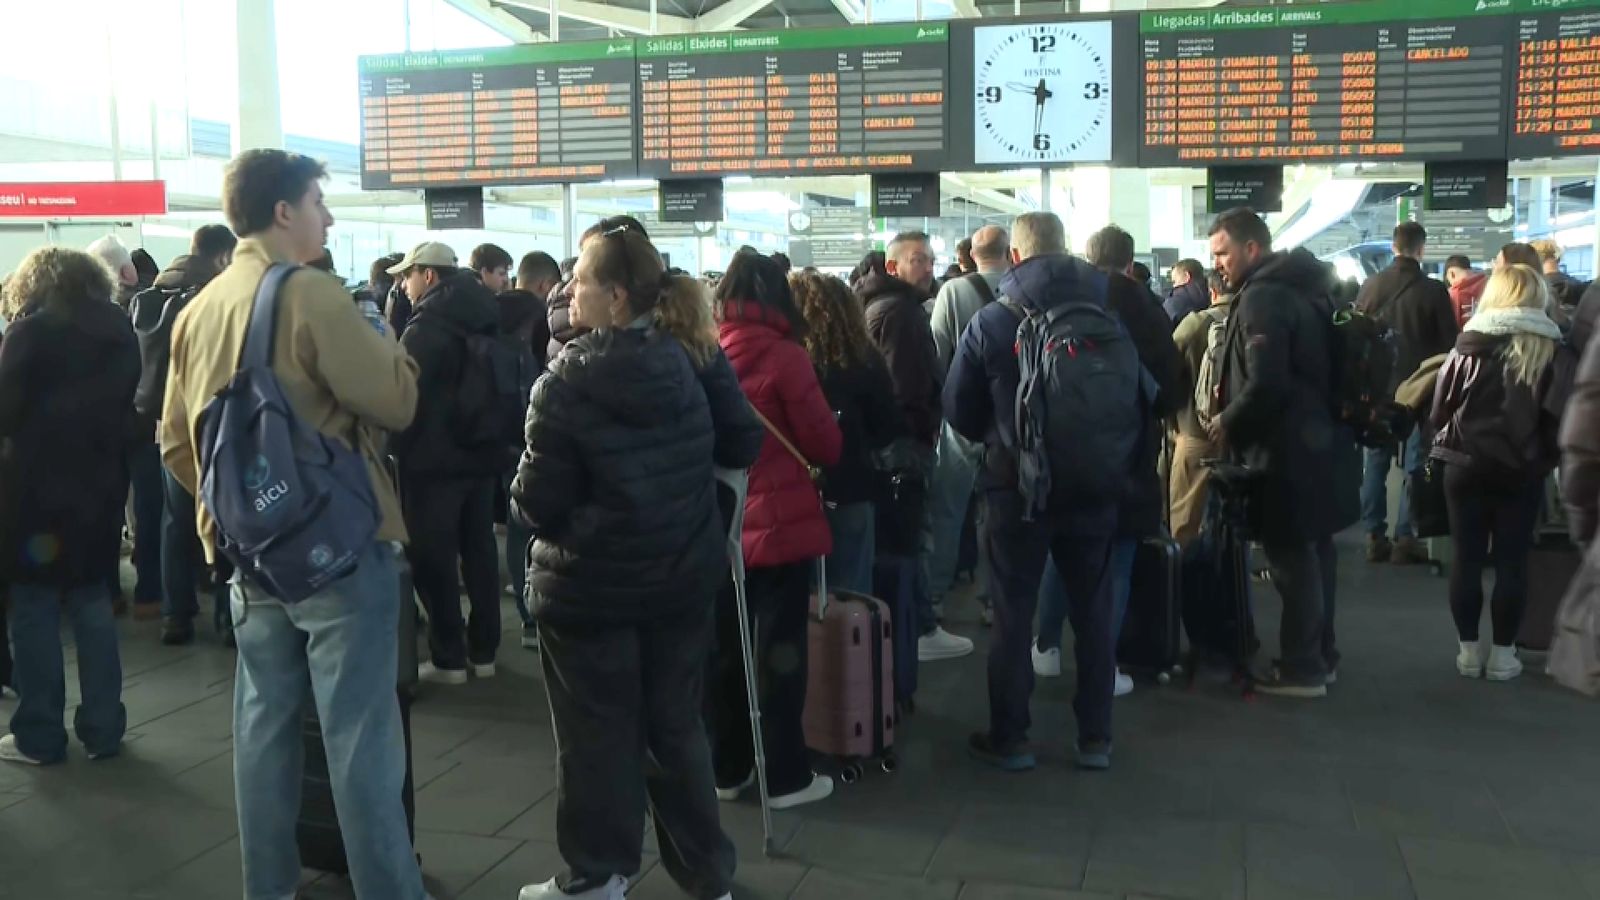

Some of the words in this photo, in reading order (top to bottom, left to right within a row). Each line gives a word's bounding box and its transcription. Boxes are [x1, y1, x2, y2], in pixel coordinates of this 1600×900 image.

[1153, 15, 1206, 29] Llegadas
[1213, 11, 1274, 25] Arribades
[1281, 11, 1321, 21] ARRIVALS
[647, 39, 684, 53] Salidas
[690, 37, 728, 49] Eixides
[733, 35, 779, 47] DEPARTURES
[1030, 35, 1056, 53] 12
[1178, 58, 1216, 68] MADRID
[1292, 55, 1310, 65] AVE
[1407, 47, 1470, 59] CANCELADO
[1024, 67, 1062, 77] FESTINA
[1178, 72, 1216, 81] MADRID
[1292, 80, 1310, 91] AVE
[985, 86, 1002, 104] 9
[1084, 82, 1101, 100] 3
[1178, 97, 1216, 106] MADRID
[1178, 109, 1216, 119] MADRID
[1292, 106, 1310, 116] AVE
[864, 117, 914, 128] CANCELADO
[1178, 122, 1216, 131] MADRID
[1292, 119, 1310, 129] AVE
[1033, 133, 1051, 151] 6
[1178, 134, 1216, 144] MADRID
[254, 480, 289, 511] aicu
